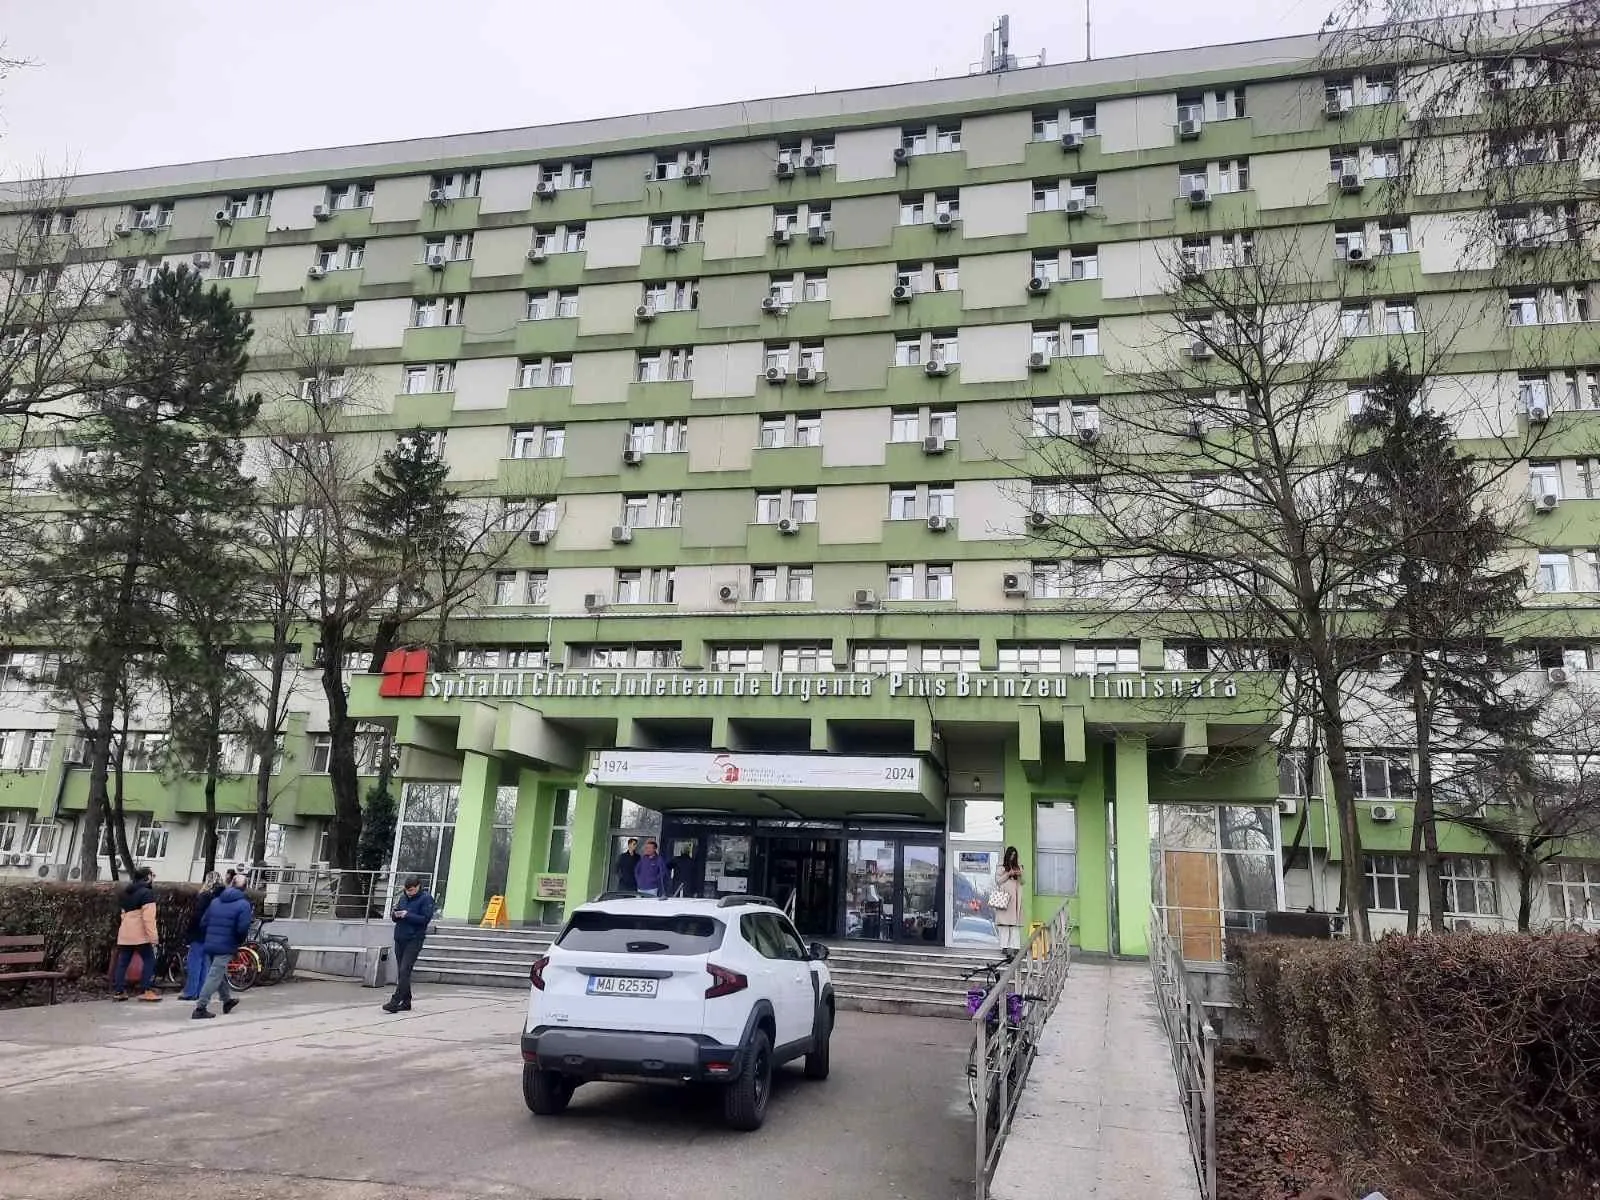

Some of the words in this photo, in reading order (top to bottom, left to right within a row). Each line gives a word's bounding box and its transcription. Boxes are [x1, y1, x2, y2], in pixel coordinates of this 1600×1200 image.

[430, 672, 523, 702] Spitalul
[532, 672, 602, 697] Clinic
[734, 671, 761, 697] de
[603, 760, 629, 773] 1974
[885, 766, 915, 781] 2024
[596, 978, 614, 991] MAI
[618, 979, 654, 993] 62535
